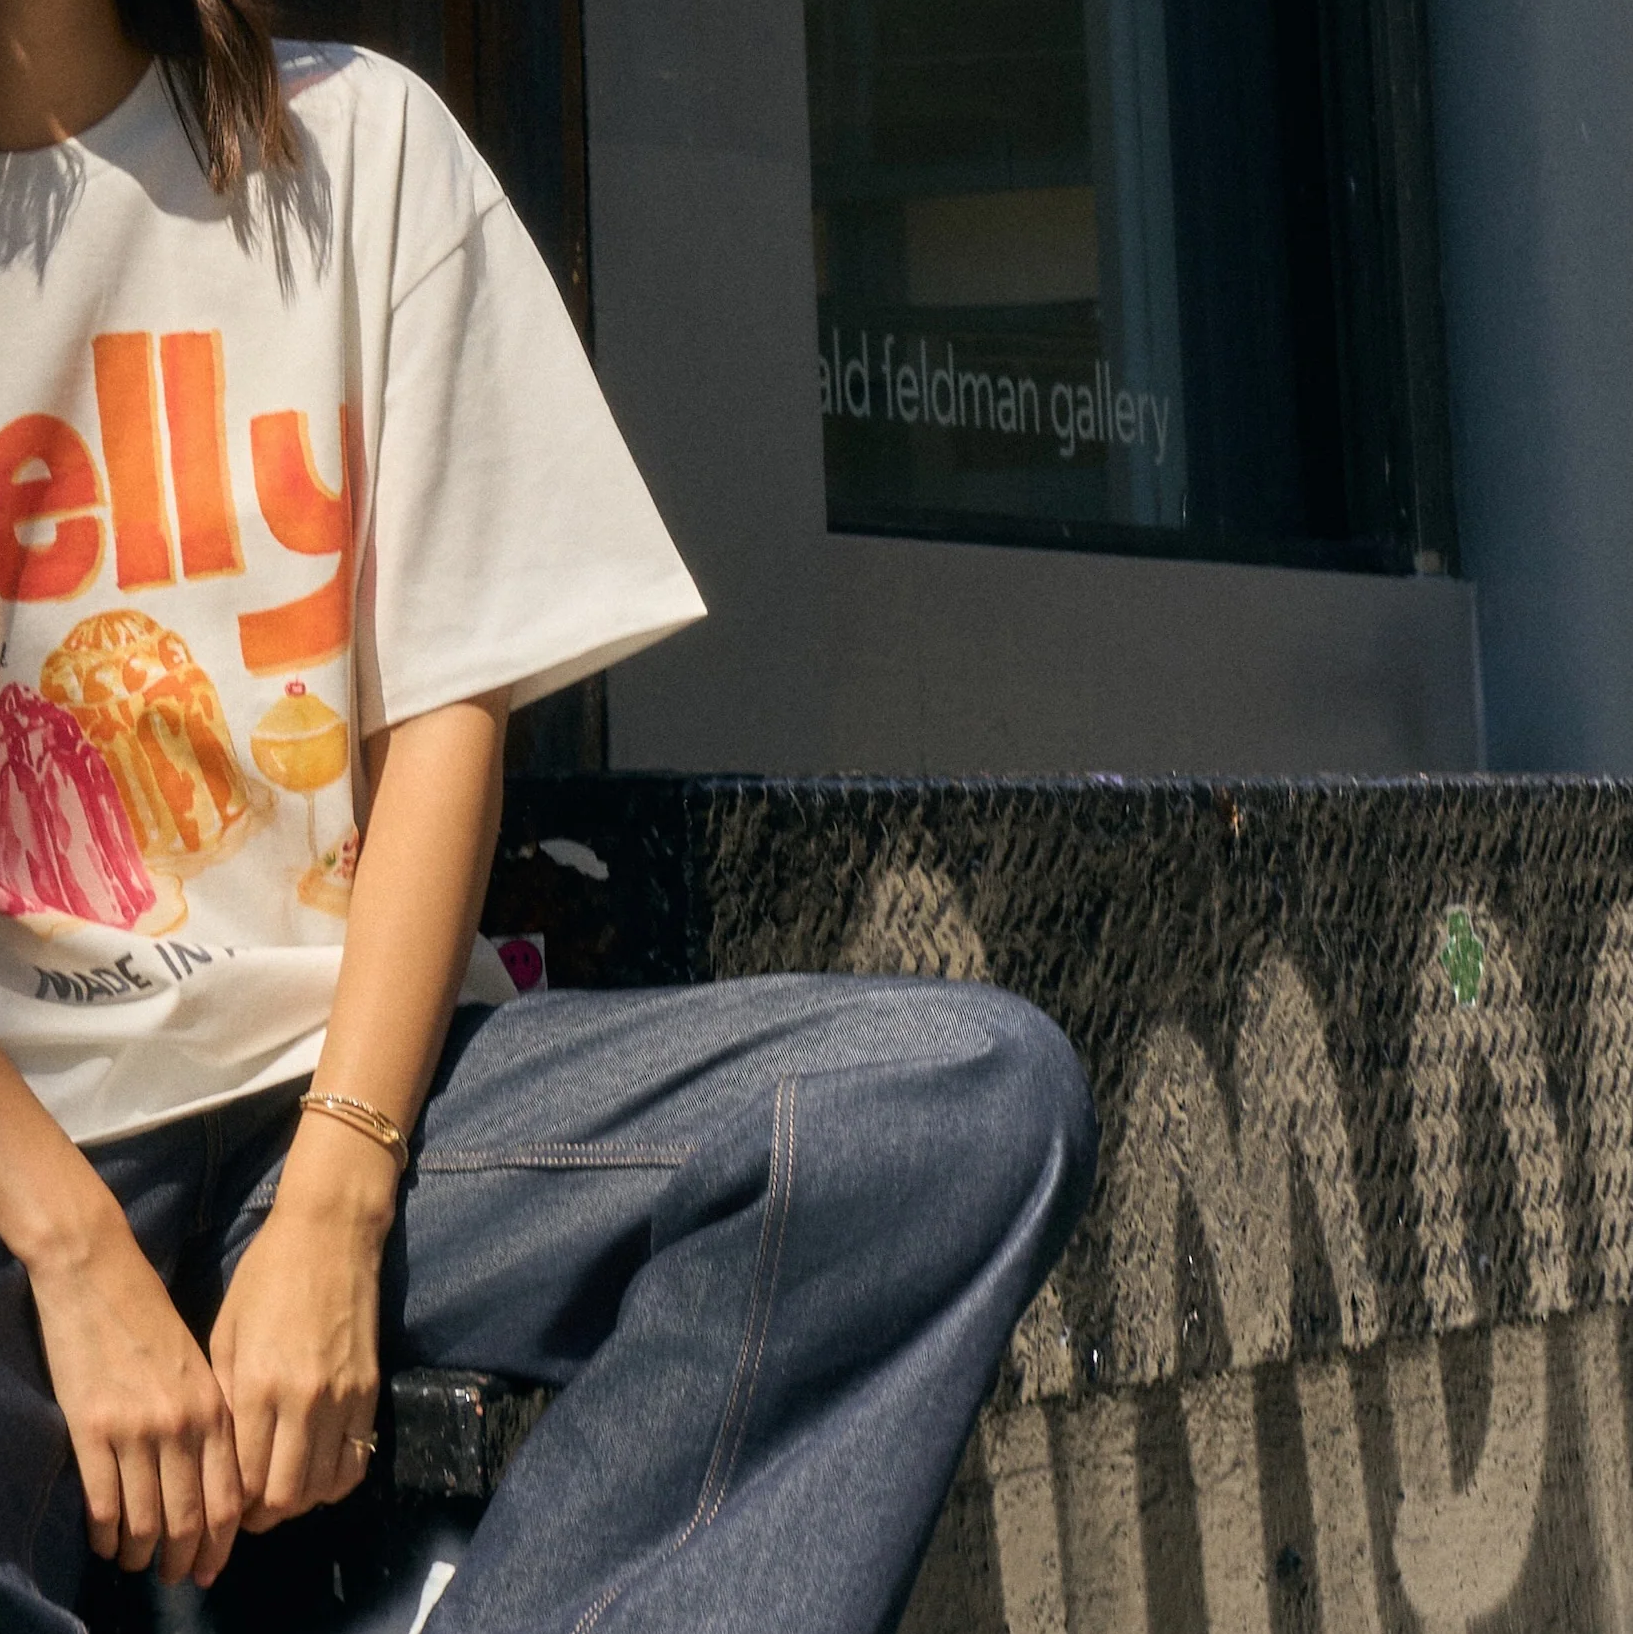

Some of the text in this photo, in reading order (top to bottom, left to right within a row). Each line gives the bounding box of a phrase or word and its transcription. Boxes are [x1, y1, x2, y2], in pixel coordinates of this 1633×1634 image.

[882, 333, 1042, 435] feldman
[1050, 359, 1172, 467] gallery
[33, 940, 213, 1002] MADE IN
